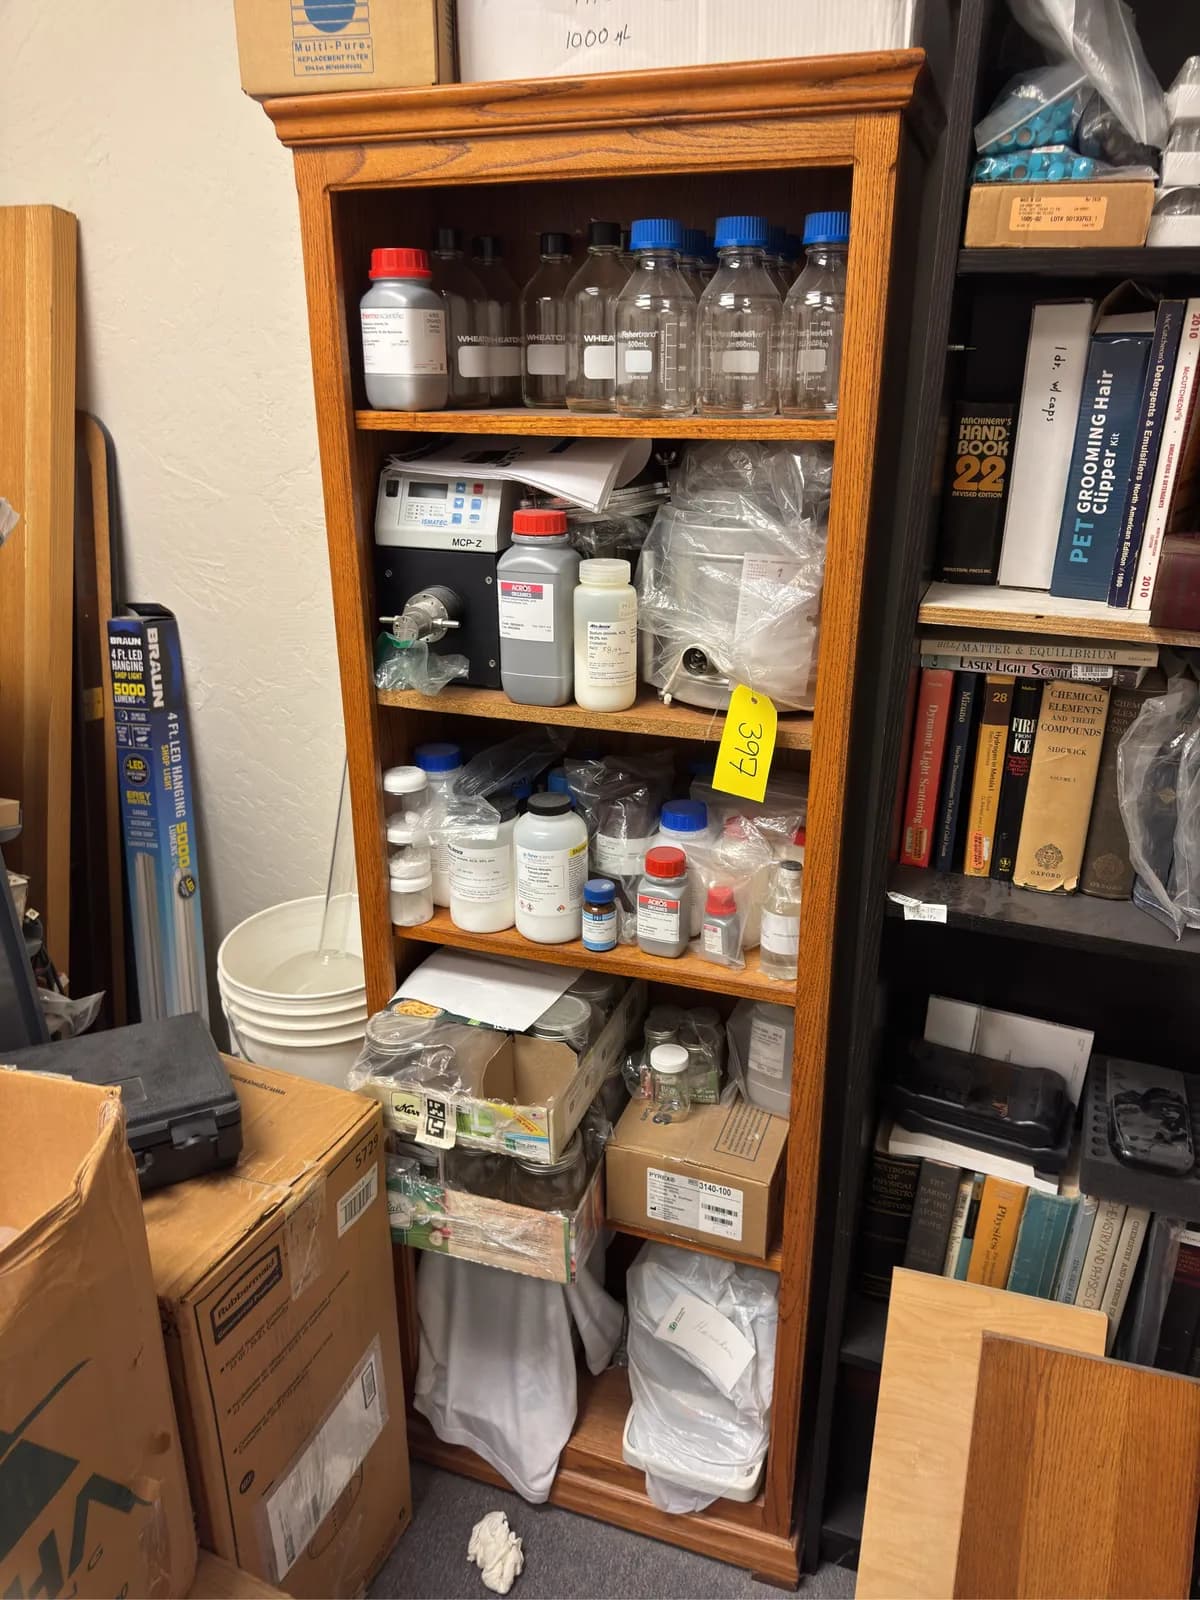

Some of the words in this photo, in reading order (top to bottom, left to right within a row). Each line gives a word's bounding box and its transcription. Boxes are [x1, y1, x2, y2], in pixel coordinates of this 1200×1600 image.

[566, 27, 609, 49] 1000
[297, 54, 345, 62] REPLACEMENT
[346, 53, 369, 61] FILTER
[1189, 313, 1200, 339] 2010
[1147, 364, 1165, 417] Detergents
[1041, 396, 1057, 422] caps
[960, 417, 1012, 426] MACHINERY'S
[1145, 419, 1154, 427] &
[957, 440, 1010, 456] BOOK
[1076, 413, 1106, 514] GROOMING
[1093, 369, 1114, 410] Hair
[1136, 430, 1153, 481] Emulsifiers
[952, 455, 1006, 492] 22
[1092, 448, 1117, 515] Clipper
[1109, 431, 1121, 447] Kit
[951, 490, 977, 498] REVISED
[977, 491, 1003, 499] EDITION
[1131, 483, 1142, 504] North
[421, 518, 448, 527] ISMATEC
[1125, 505, 1137, 540] American
[1069, 518, 1095, 563] PET
[1119, 541, 1131, 567] Edition
[511, 584, 532, 592] ACROS
[1140, 576, 1152, 598] 2010
[110, 636, 142, 646] BRAUN
[111, 648, 117, 660] 4
[128, 649, 143, 661] LED
[1014, 646, 1024, 656] &
[1028, 646, 1118, 661] EQUILIBRIUM
[111, 660, 144, 672] HANGING
[147, 627, 165, 708] BRAUN
[113, 682, 146, 697] 5000
[992, 692, 1008, 703] 28
[1050, 689, 1105, 703] CHEMICAL
[167, 712, 178, 721] 4
[959, 691, 971, 723] Mizuno
[1048, 702, 1104, 715] ELEMENTS
[168, 722, 180, 740] Ft.
[924, 703, 938, 747] Dynamic
[1041, 723, 1102, 737] COMPOUNDS
[1071, 716, 1096, 725] THEIR
[161, 744, 170, 767] SHOP
[169, 740, 182, 763] LED
[728, 722, 764, 778] 397
[992, 731, 1002, 763] Hydrogen
[1013, 739, 1032, 754] ICE
[1047, 745, 1088, 757] SIDGWICK
[129, 759, 144, 770] LED
[919, 749, 933, 776] Light
[163, 767, 173, 791] LIGHT
[172, 765, 187, 819] HANGING
[912, 777, 931, 825] Scattering
[176, 821, 191, 869] 5000
[1030, 870, 1061, 880] OXFORD
[394, 1102, 421, 1117] Kerr
[355, 1134, 379, 1169] 5729
[698, 1181, 732, 1197] 3140-100
[991, 1204, 1007, 1251] Physics
[1125, 1221, 1140, 1261] CHEMISTRY
[1094, 1245, 1108, 1265] AND
[1119, 1262, 1129, 1278] AND
[217, 1257, 275, 1319] Rubbermaid
[1085, 1265, 1103, 1299] PHYSICS
